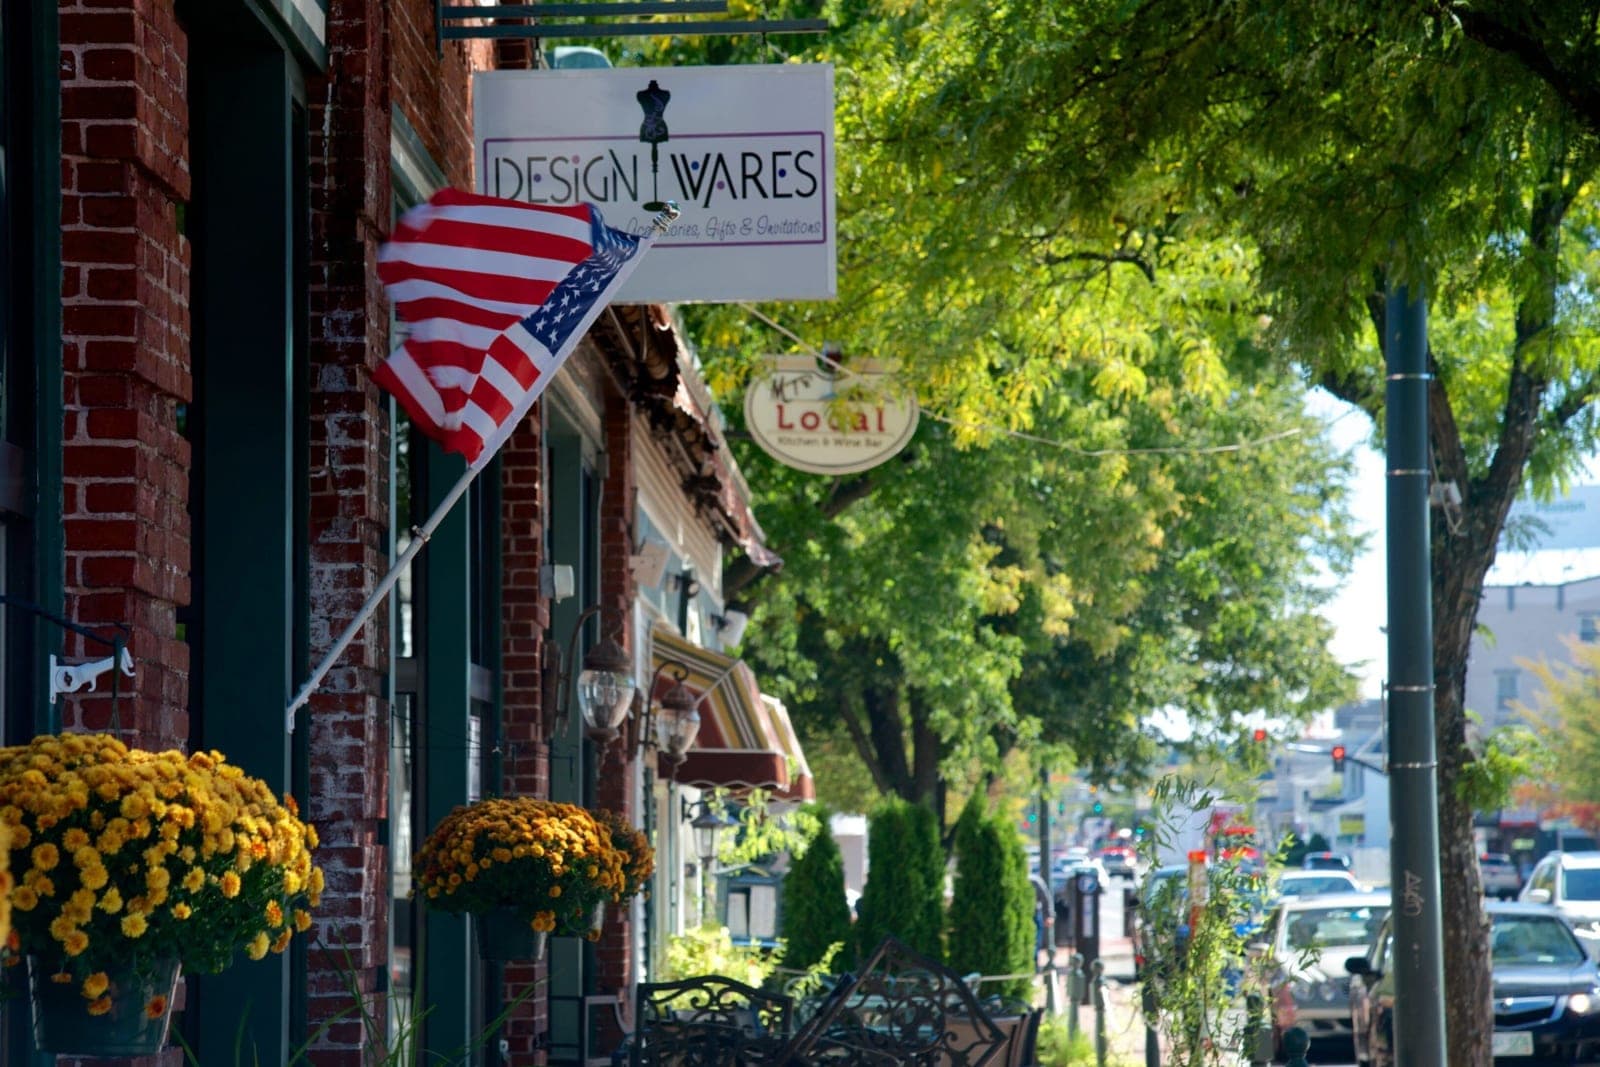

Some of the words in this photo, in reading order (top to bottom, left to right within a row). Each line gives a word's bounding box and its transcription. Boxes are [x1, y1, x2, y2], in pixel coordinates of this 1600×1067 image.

[670, 150, 818, 208] WARES
[706, 216, 736, 240] Gifts
[740, 217, 753, 236] &
[757, 215, 821, 236] Invitations
